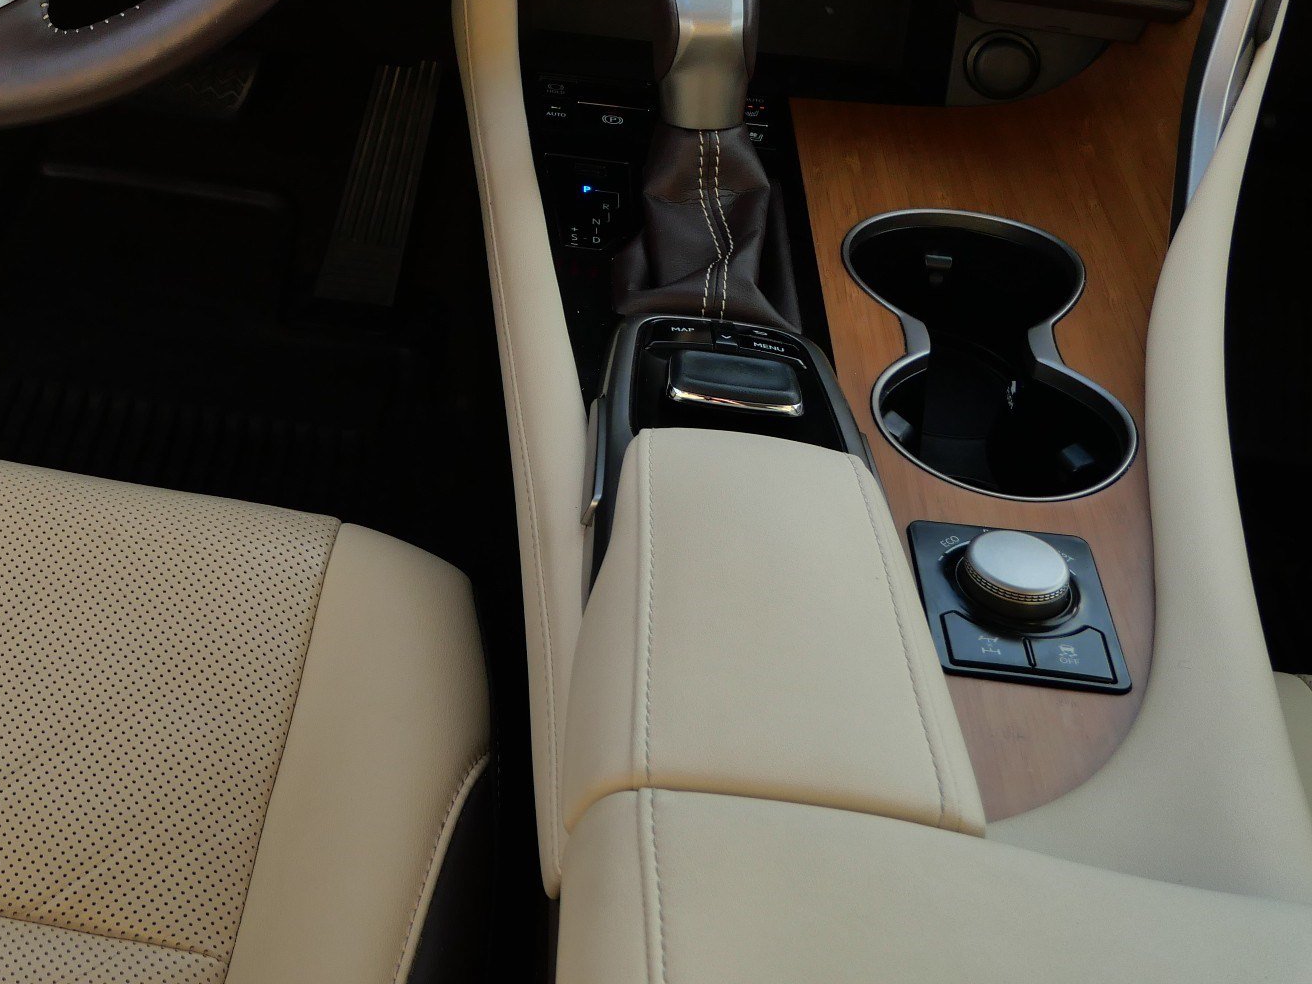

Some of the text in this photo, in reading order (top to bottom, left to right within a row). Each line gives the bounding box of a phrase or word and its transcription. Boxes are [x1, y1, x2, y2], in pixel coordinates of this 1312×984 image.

[583, 185, 592, 193] P
[602, 203, 610, 211] R
[571, 233, 578, 241] S
[753, 341, 785, 352] MENU
[940, 535, 960, 548] ECO
